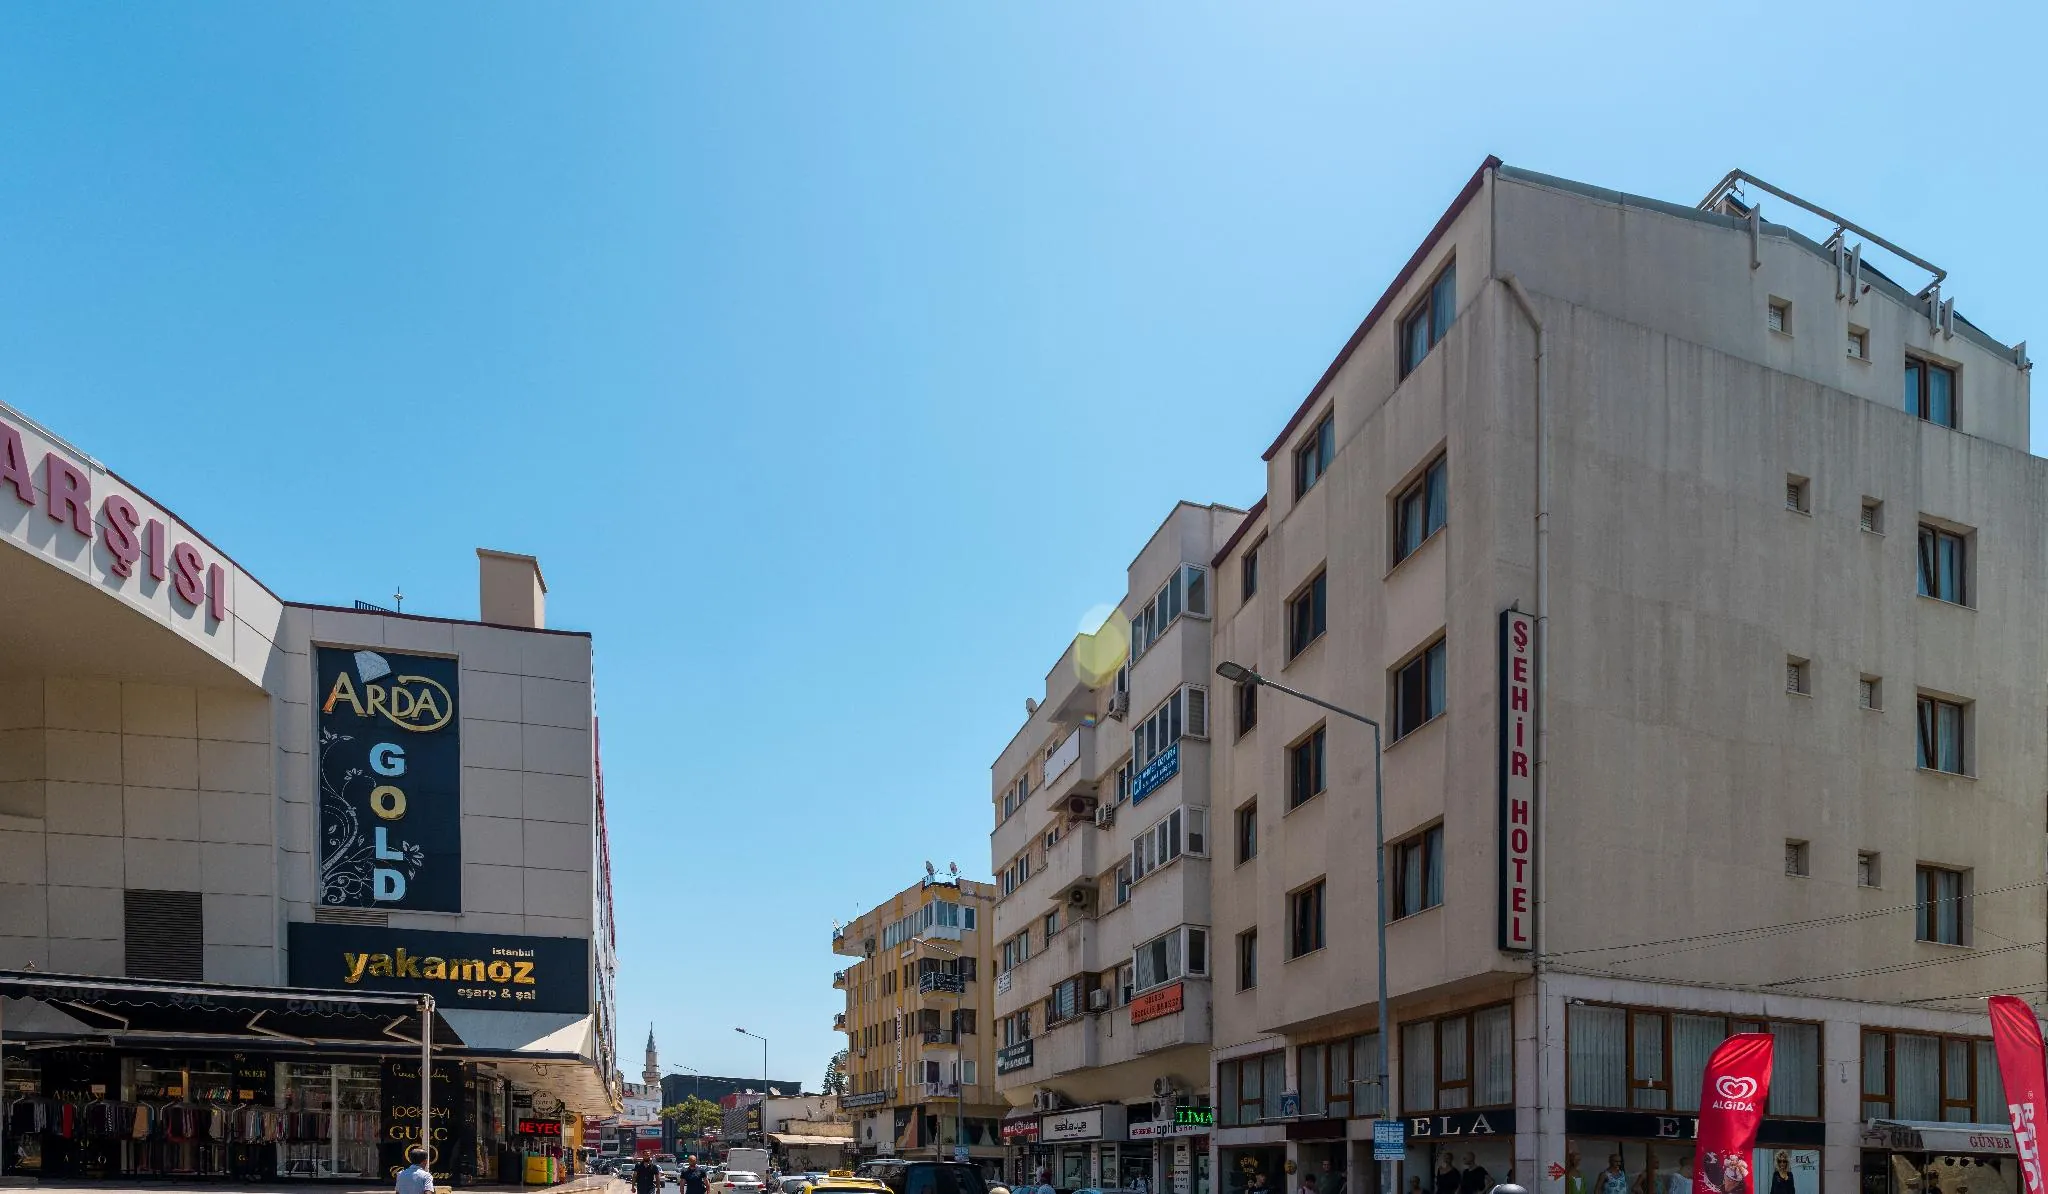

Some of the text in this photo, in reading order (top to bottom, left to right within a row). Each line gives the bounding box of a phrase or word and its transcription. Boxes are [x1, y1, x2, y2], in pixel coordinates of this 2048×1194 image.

[321, 671, 453, 732] ARDA
[1511, 620, 1528, 942] ŞEHİR HOTEL
[369, 742, 408, 901] GOLD
[343, 946, 536, 985] yakamoz
[492, 947, 535, 957] istanbul
[457, 987, 536, 1001] eşarp & şal
[1411, 1113, 1496, 1137] ELA
[1969, 1133, 2012, 1149] GÜNER
